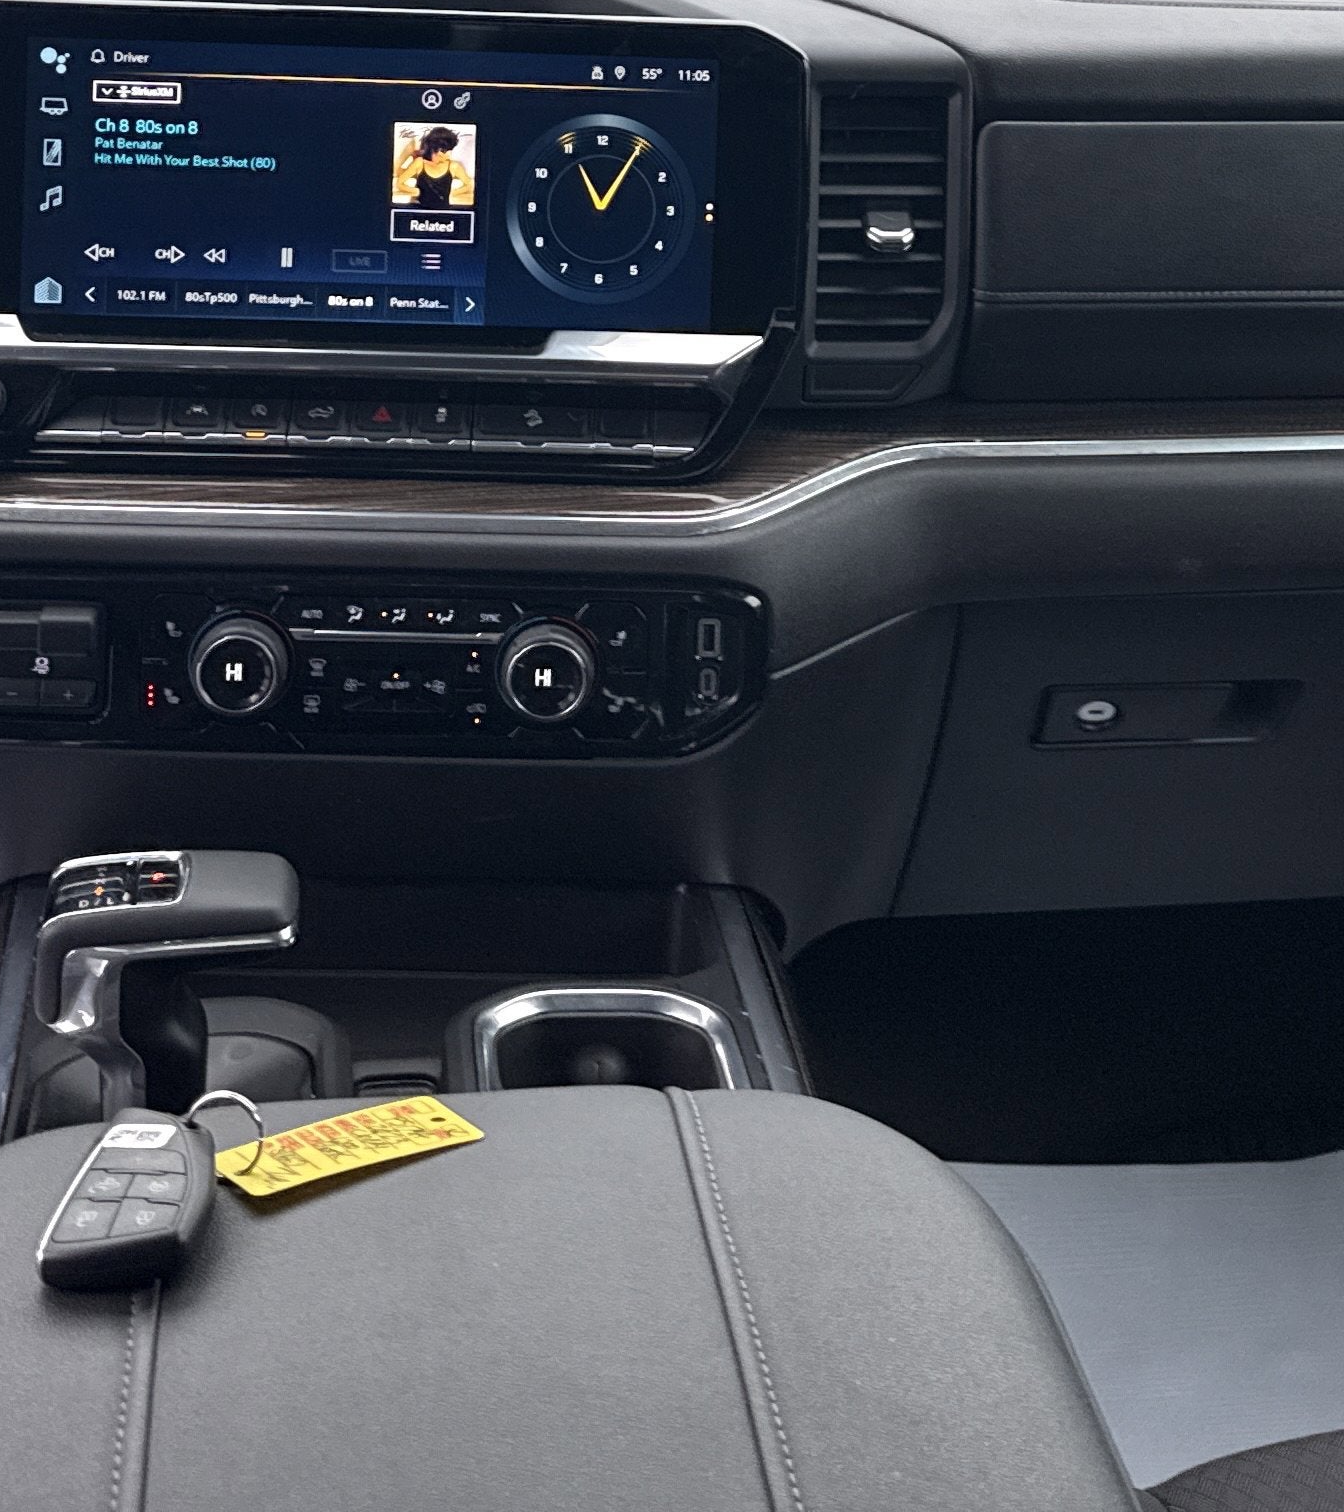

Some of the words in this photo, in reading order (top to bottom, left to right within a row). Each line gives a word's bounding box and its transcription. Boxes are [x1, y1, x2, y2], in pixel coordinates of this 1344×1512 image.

[114, 51, 150, 64] Driver
[678, 69, 711, 82] 11:05
[95, 118, 116, 133] Ch
[119, 119, 130, 133] 8
[135, 120, 163, 134] 80s
[165, 124, 185, 134] on
[188, 121, 198, 134] 8
[95, 137, 114, 149] Pat
[117, 138, 163, 150] Benatar
[597, 135, 609, 146] 12
[94, 153, 112, 165] Hit
[114, 154, 133, 166] Me
[135, 154, 163, 166] With
[164, 155, 190, 167] Your
[193, 156, 219, 168] Best
[222, 156, 248, 168] Shot
[250, 157, 276, 171] (80)
[535, 168, 548, 179] 10
[658, 172, 667, 183] 2
[528, 201, 537, 213] 9
[666, 206, 675, 217] 3
[410, 220, 455, 233] Related
[535, 237, 544, 248] 8
[655, 240, 663, 251] 4
[99, 247, 115, 258] CH
[154, 249, 171, 259] CH
[560, 263, 568, 274] 7
[630, 265, 638, 276] 5
[594, 273, 603, 284] 6
[117, 290, 146, 301] 102.1
[149, 291, 166, 302] FM
[185, 291, 238, 305] 80sTp500
[328, 295, 348, 307] 80s
[349, 298, 364, 307] on
[365, 296, 374, 307] 8
[390, 297, 416, 308] Penn
[225, 662, 243, 682] HI
[534, 668, 552, 687] HI
